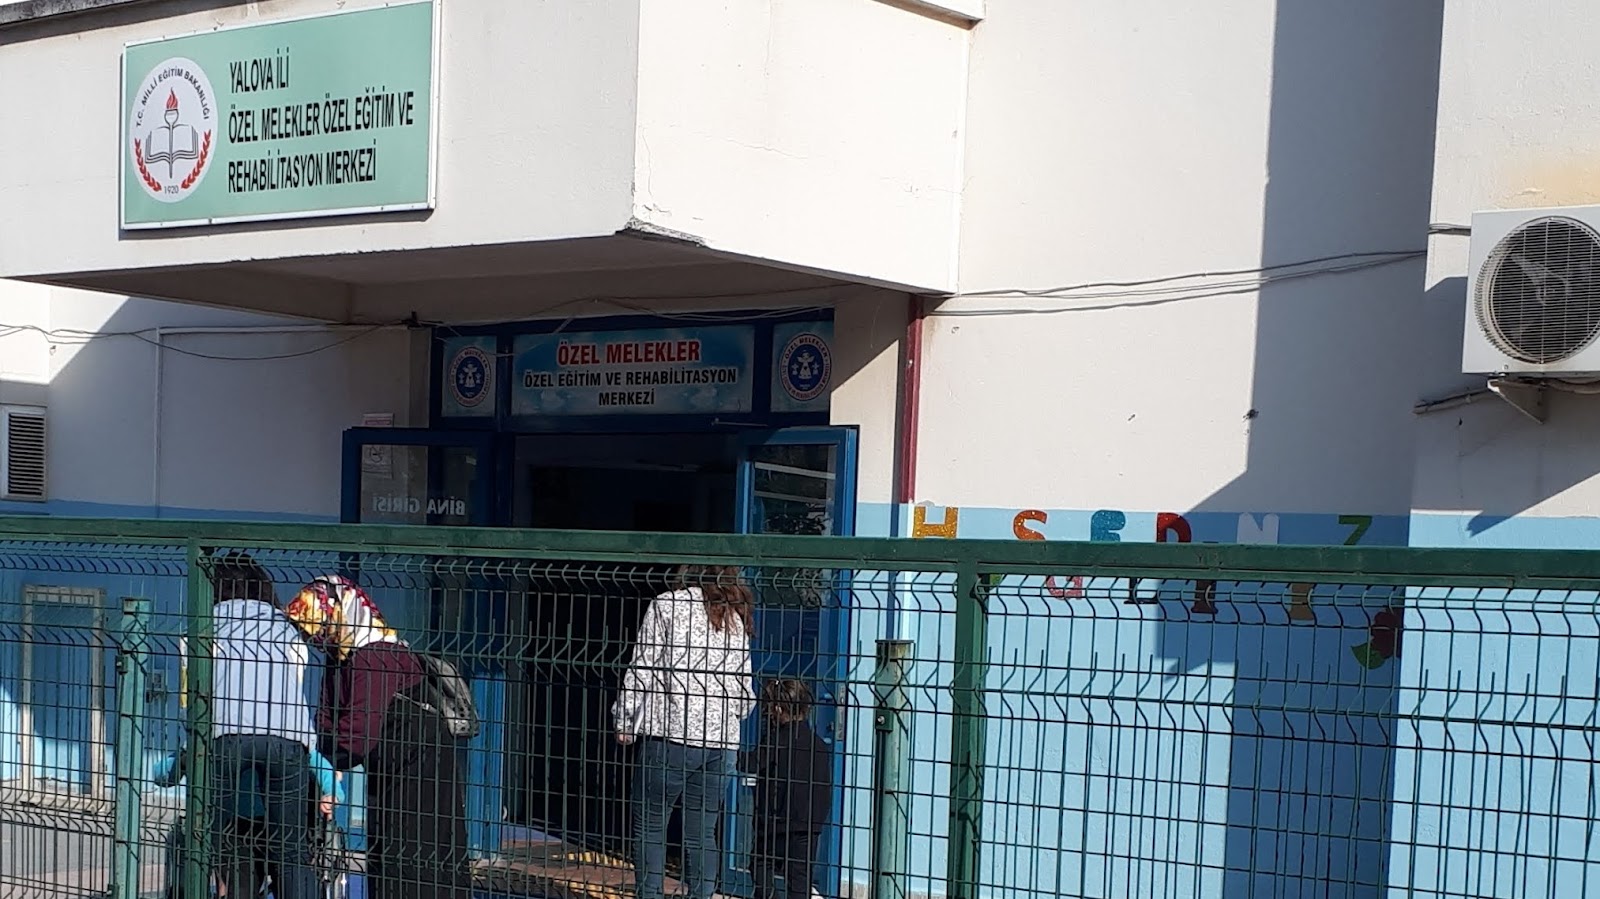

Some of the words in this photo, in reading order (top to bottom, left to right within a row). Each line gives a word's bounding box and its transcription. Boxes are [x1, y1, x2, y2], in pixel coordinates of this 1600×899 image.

[230, 57, 274, 94] YALOVA
[276, 46, 290, 89] İLİ
[136, 109, 145, 127] T.C.
[141, 76, 158, 106] MİLLİ
[158, 65, 184, 83] EĞİTİM
[184, 70, 210, 120] BAKANLIĞI
[228, 103, 258, 144] ÖZEL
[261, 102, 320, 141] MELEKLER
[323, 92, 352, 134] ÖZEL
[355, 85, 395, 131] EĞİTİM
[398, 91, 414, 126] VE
[228, 148, 323, 193] REHABİLİTASYON
[325, 138, 376, 185] MERKEZİ
[164, 185, 179, 194] 1920
[557, 341, 600, 365] ÖZEL
[606, 341, 700, 363] MELEKLER
[524, 371, 554, 388] ÖZEL
[558, 369, 601, 387] EĞİTİM
[605, 371, 622, 386] VE
[625, 366, 737, 386] REHABİLİTASYON
[598, 388, 655, 406] MERKEZİ
